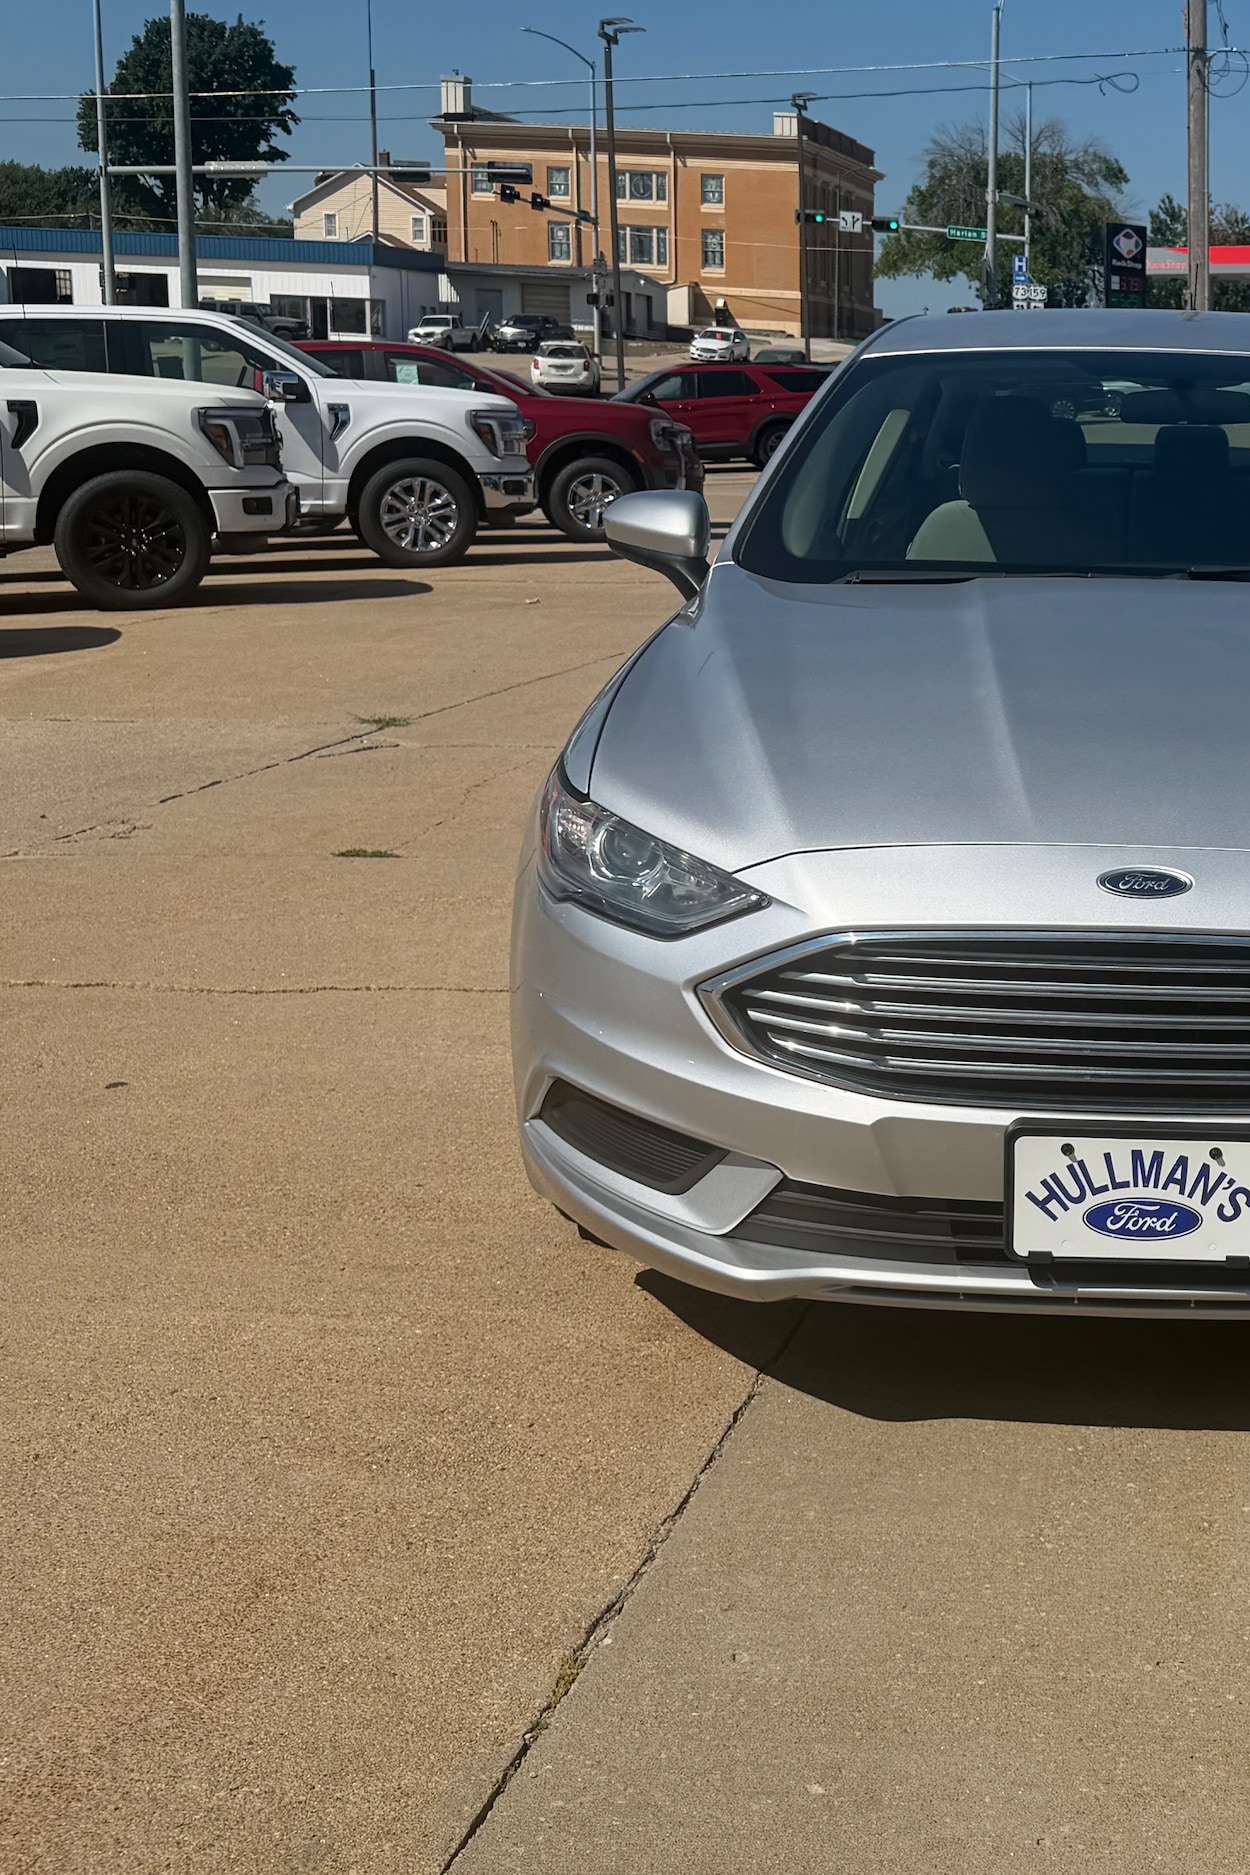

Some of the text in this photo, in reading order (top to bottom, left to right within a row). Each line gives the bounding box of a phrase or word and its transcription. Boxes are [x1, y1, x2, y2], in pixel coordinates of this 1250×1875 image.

[980, 231, 988, 240] S
[1014, 256, 1027, 272] H
[1014, 286, 1027, 297] 73
[1029, 288, 1047, 298] 159
[1118, 872, 1171, 891] Ford
[1106, 1203, 1179, 1234] Ford
